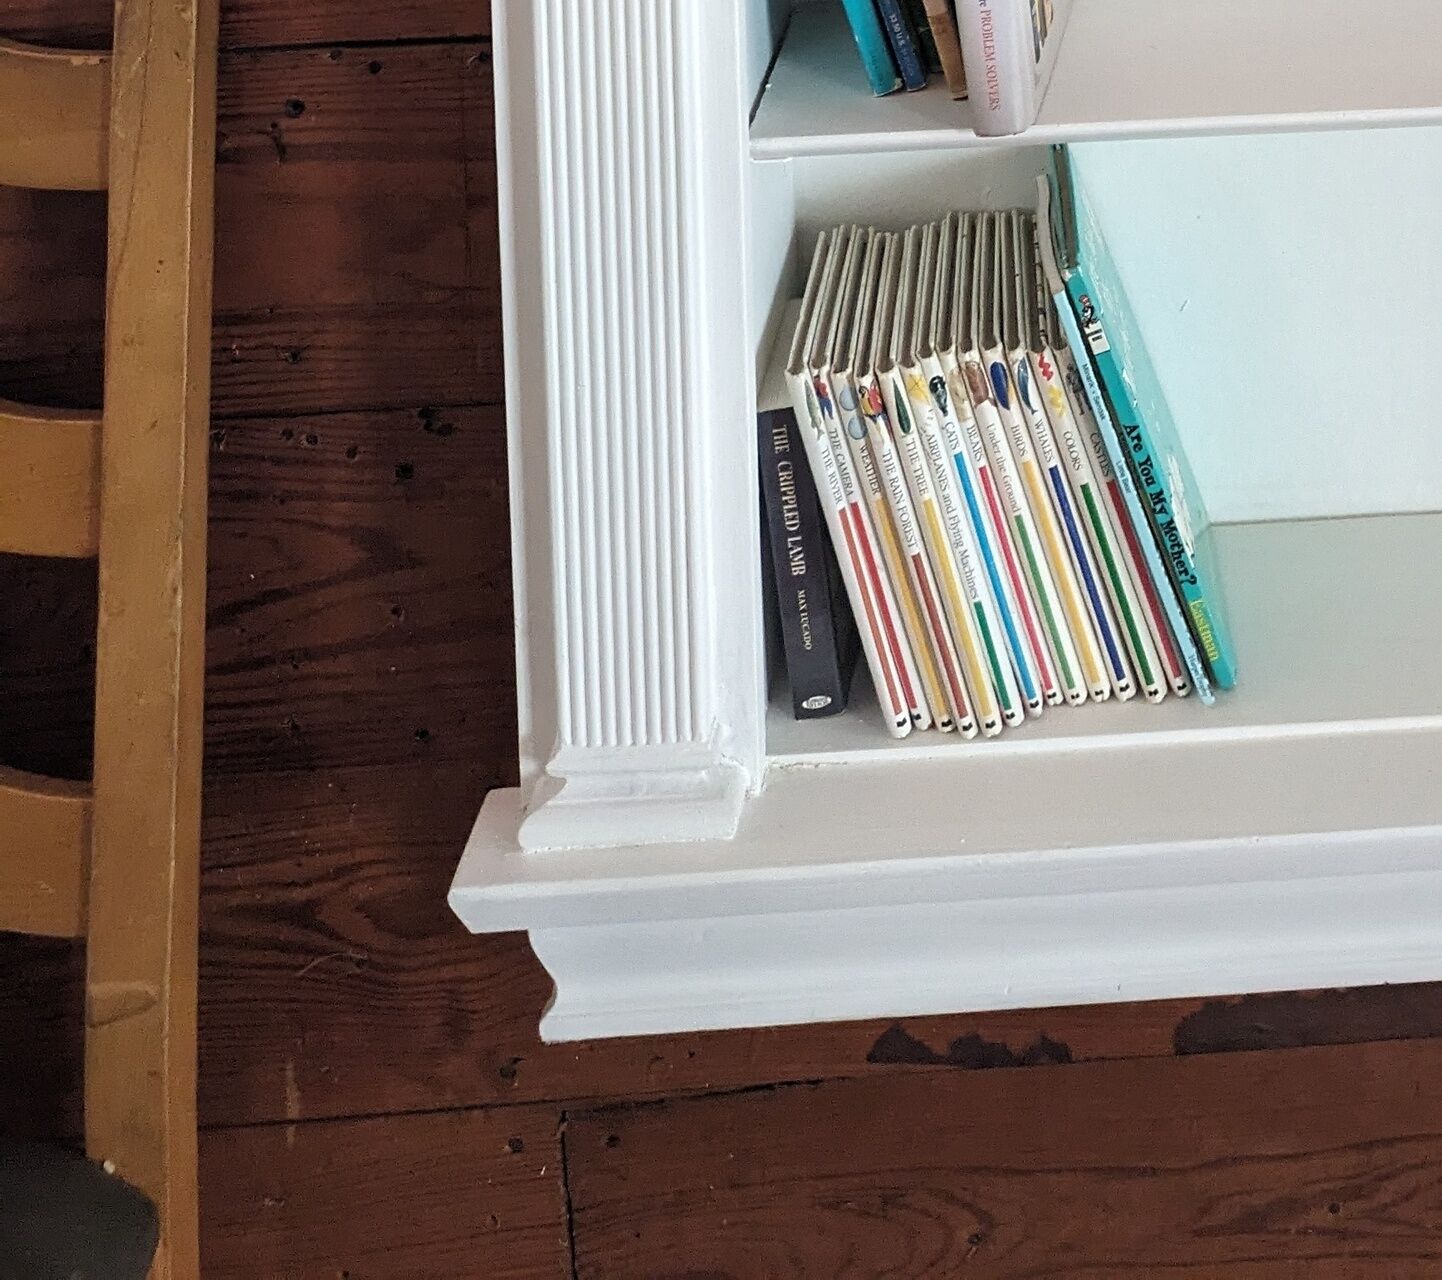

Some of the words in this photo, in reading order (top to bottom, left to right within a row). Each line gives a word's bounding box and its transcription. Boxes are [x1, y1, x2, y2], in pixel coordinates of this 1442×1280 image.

[980, 9, 995, 64] PROBLEM
[984, 64, 1000, 111] SOLVERS
[772, 424, 790, 454] THE
[943, 421, 961, 451] CATS
[966, 424, 985, 463] BEARS
[1010, 424, 1028, 457] BIRDS
[1034, 418, 1055, 463] WHALES
[1063, 430, 1081, 472] COLORS
[1089, 432, 1111, 477] CASTLES
[821, 446, 834, 468] THE
[828, 470, 843, 505] RIVER
[829, 428, 842, 451] THE
[836, 453, 854, 497] CAMERA
[860, 444, 881, 496] WEATHER
[905, 437, 918, 462] THE
[913, 465, 929, 497] TREE
[927, 433, 950, 492] AIRPLANES
[986, 422, 1001, 454] Under
[995, 454, 1007, 473] the
[1002, 474, 1022, 513] Ground
[777, 460, 801, 532] CRIPPLED
[882, 448, 896, 476] THE
[889, 476, 905, 504] RAIN
[897, 505, 918, 549] FOREST
[942, 493, 957, 514] and
[948, 512, 964, 550] Flying
[1123, 424, 1143, 453] Are
[1138, 454, 1157, 487] You
[1149, 487, 1168, 516] My
[1160, 518, 1197, 586] Mother?
[1189, 600, 1219, 662] Eastman
[787, 536, 807, 577] LAMB
[958, 548, 979, 600] Machines
[797, 590, 808, 612] MAX
[800, 612, 813, 650] LUCADO
